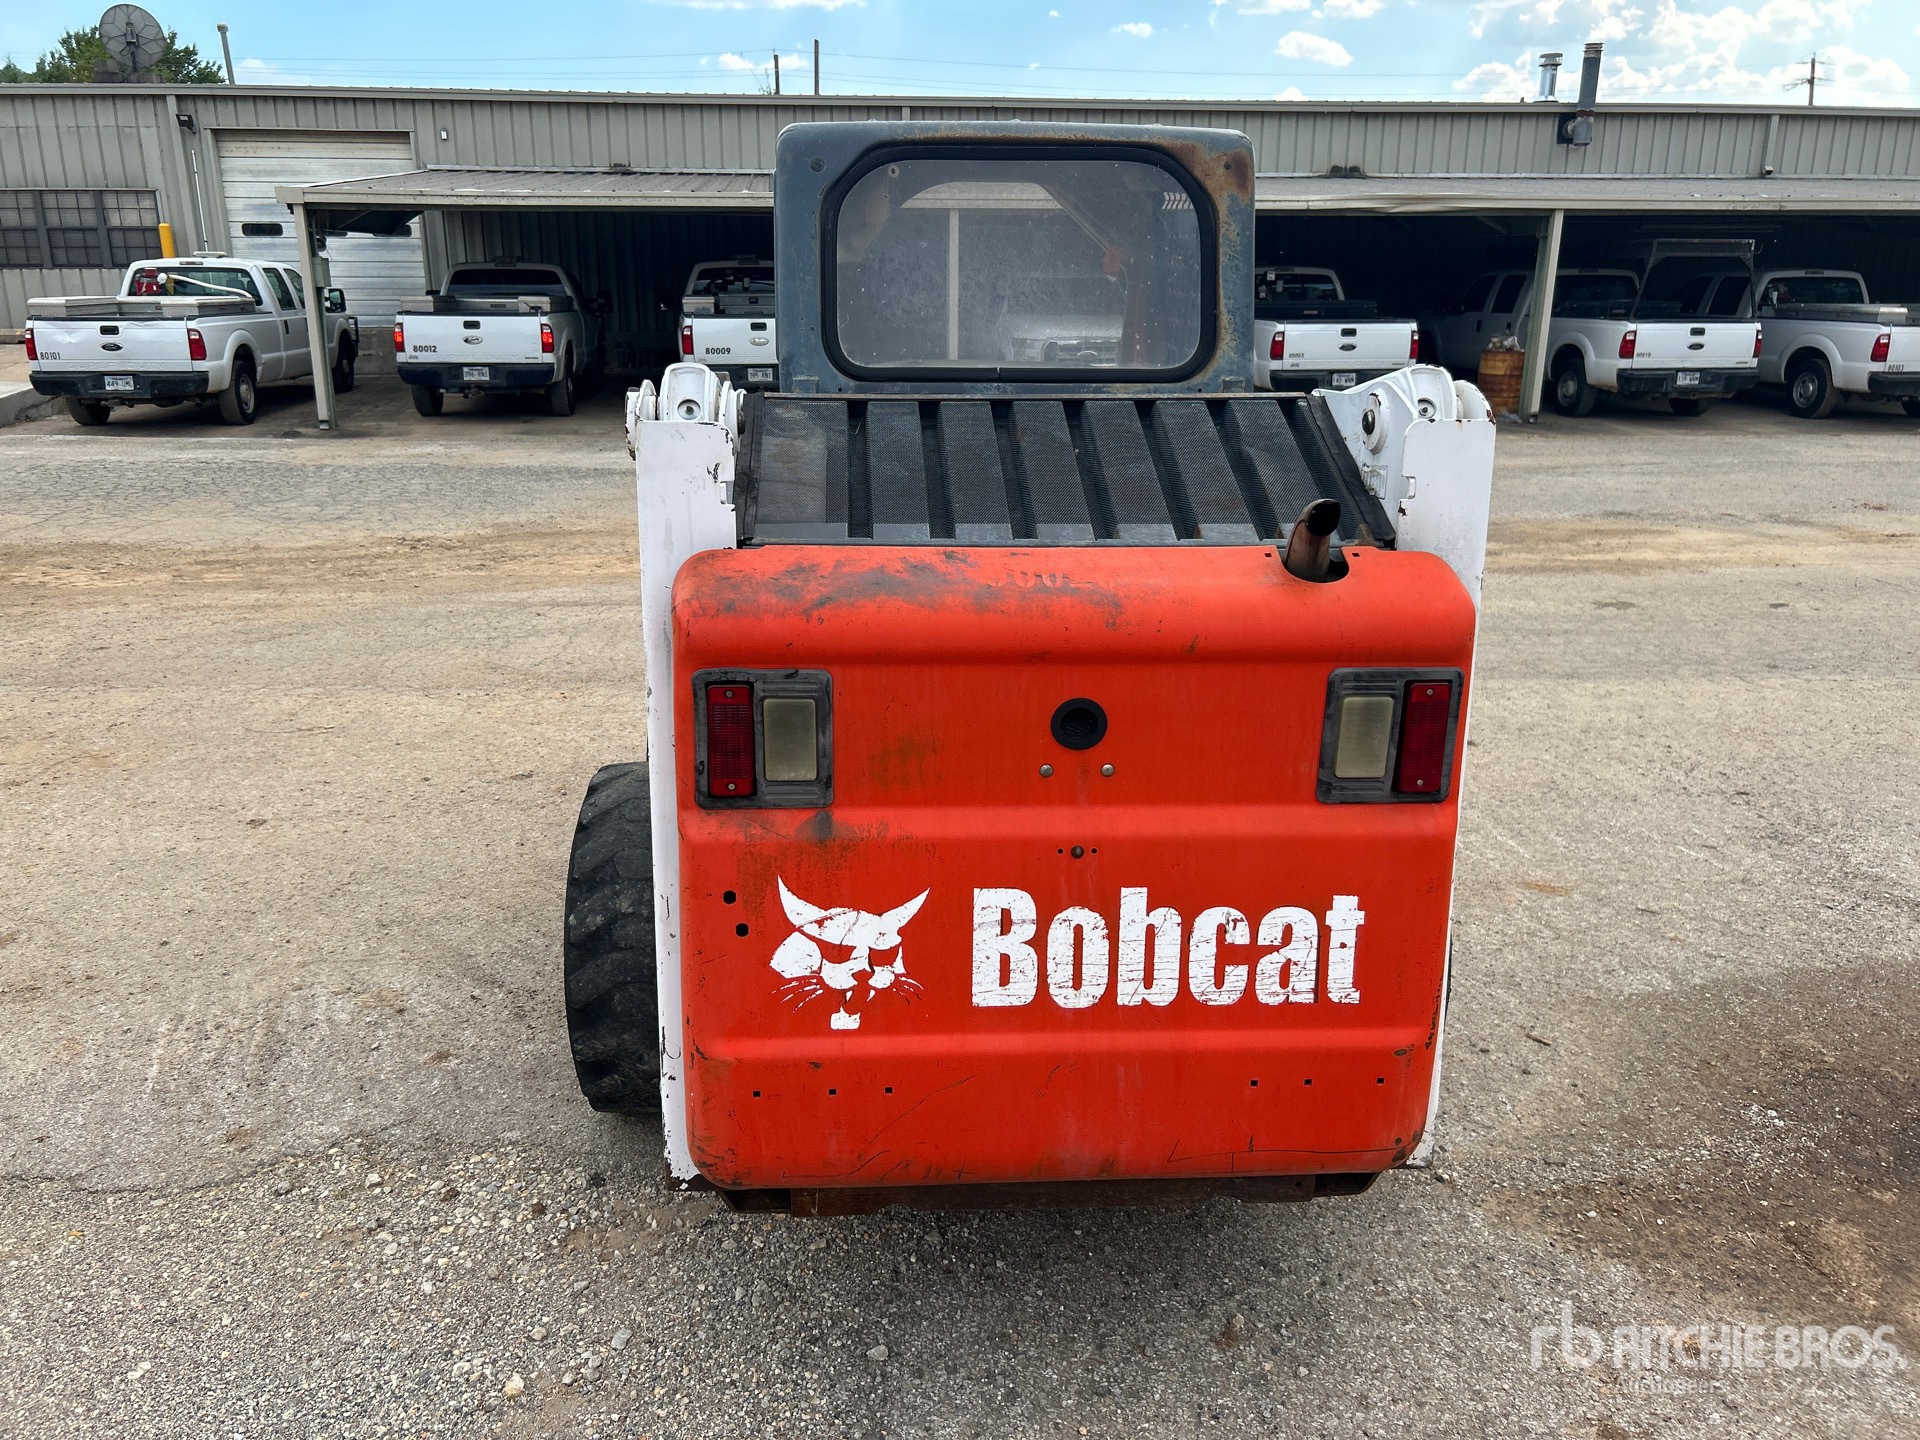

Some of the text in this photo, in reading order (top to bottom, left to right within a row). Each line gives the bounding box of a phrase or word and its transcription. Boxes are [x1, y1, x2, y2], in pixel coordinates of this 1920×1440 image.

[413, 345, 437, 353] 80012
[40, 352, 61, 360] 80101
[972, 886, 1365, 1008] Bobcat
